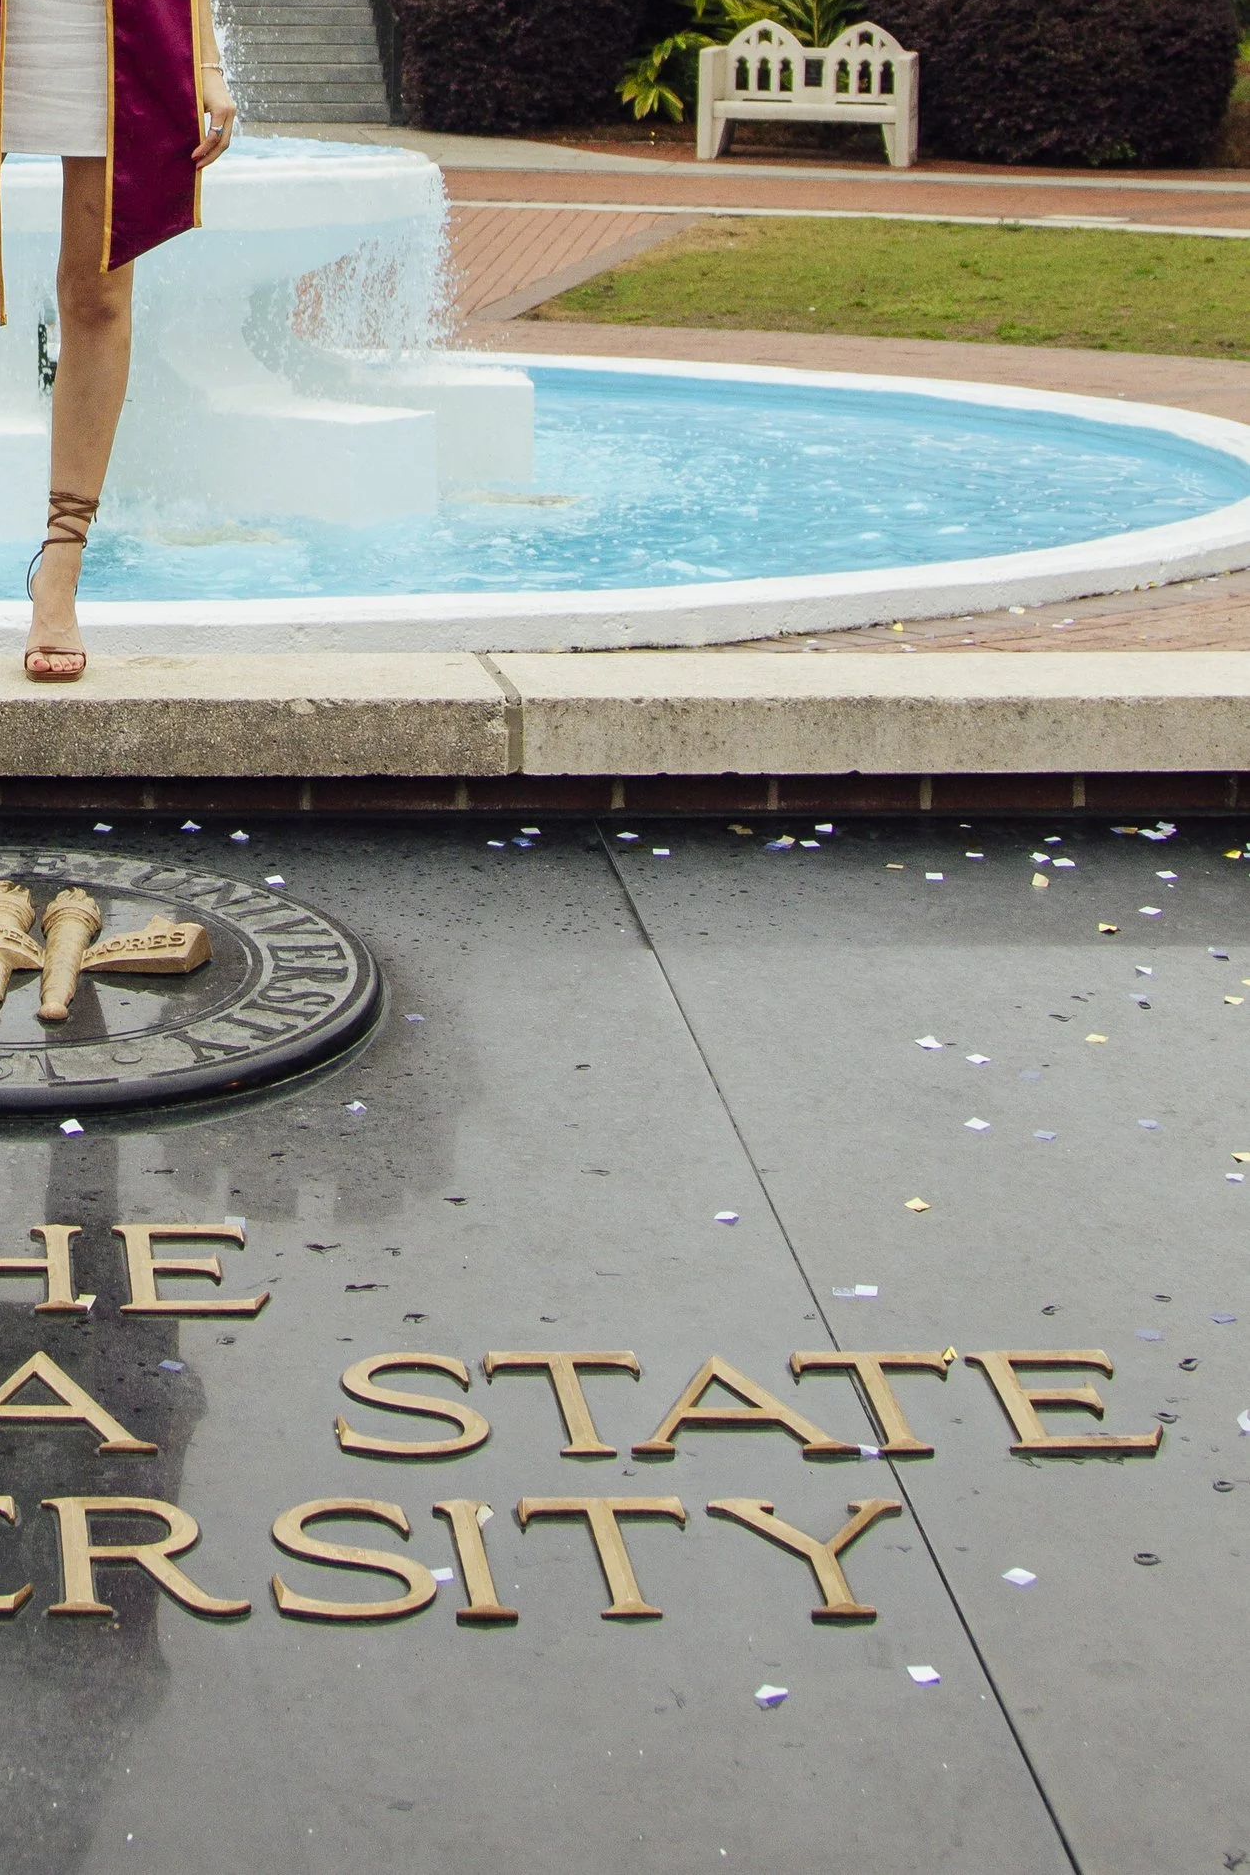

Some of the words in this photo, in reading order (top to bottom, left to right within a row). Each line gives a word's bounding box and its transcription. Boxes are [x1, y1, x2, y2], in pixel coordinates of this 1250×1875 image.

[84, 930, 186, 961] MORES
[131, 866, 348, 1063] UNIVERSITY
[336, 1350, 1164, 1460] STATE
